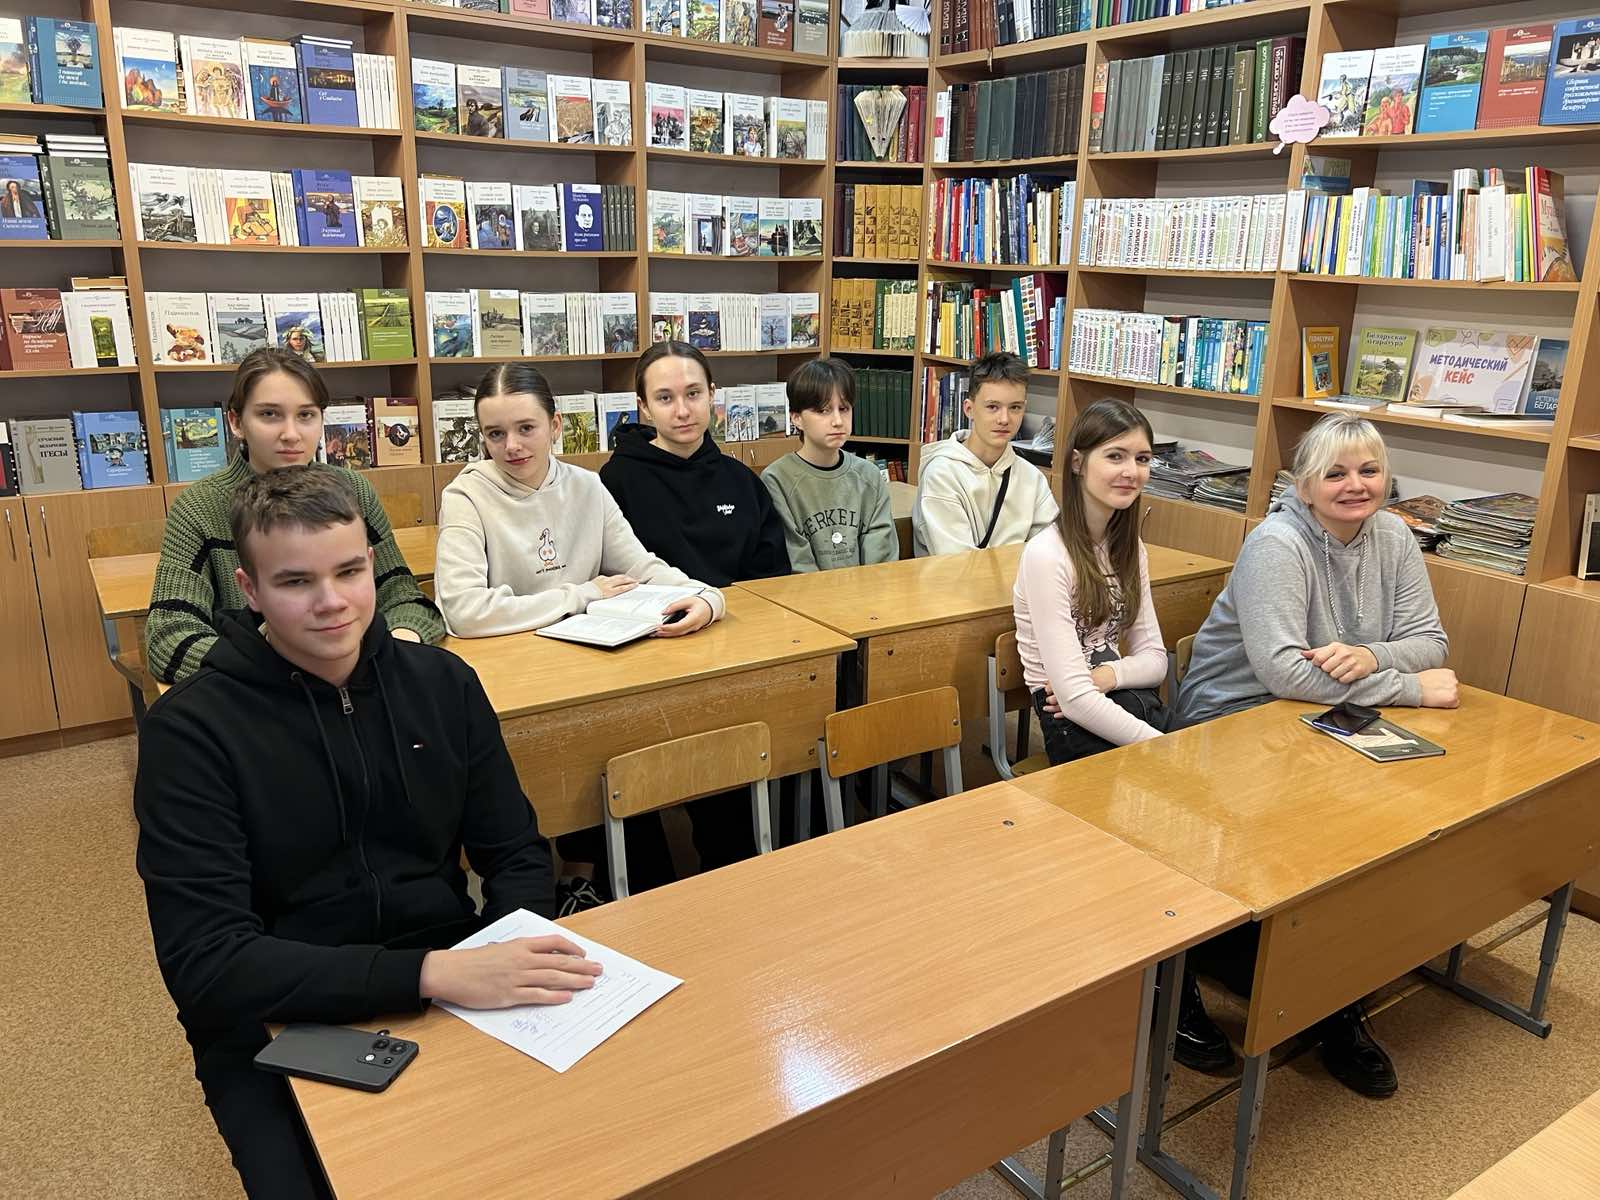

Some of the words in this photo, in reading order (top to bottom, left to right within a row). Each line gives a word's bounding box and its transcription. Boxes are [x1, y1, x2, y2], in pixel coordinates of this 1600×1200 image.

[1562, 91, 1600, 99] русскоязычн
[1429, 354, 1508, 372] МЕТОДИЧЕСКИЙ
[1444, 369, 1474, 384] КЕЙС
[801, 508, 865, 540] ERKEL
